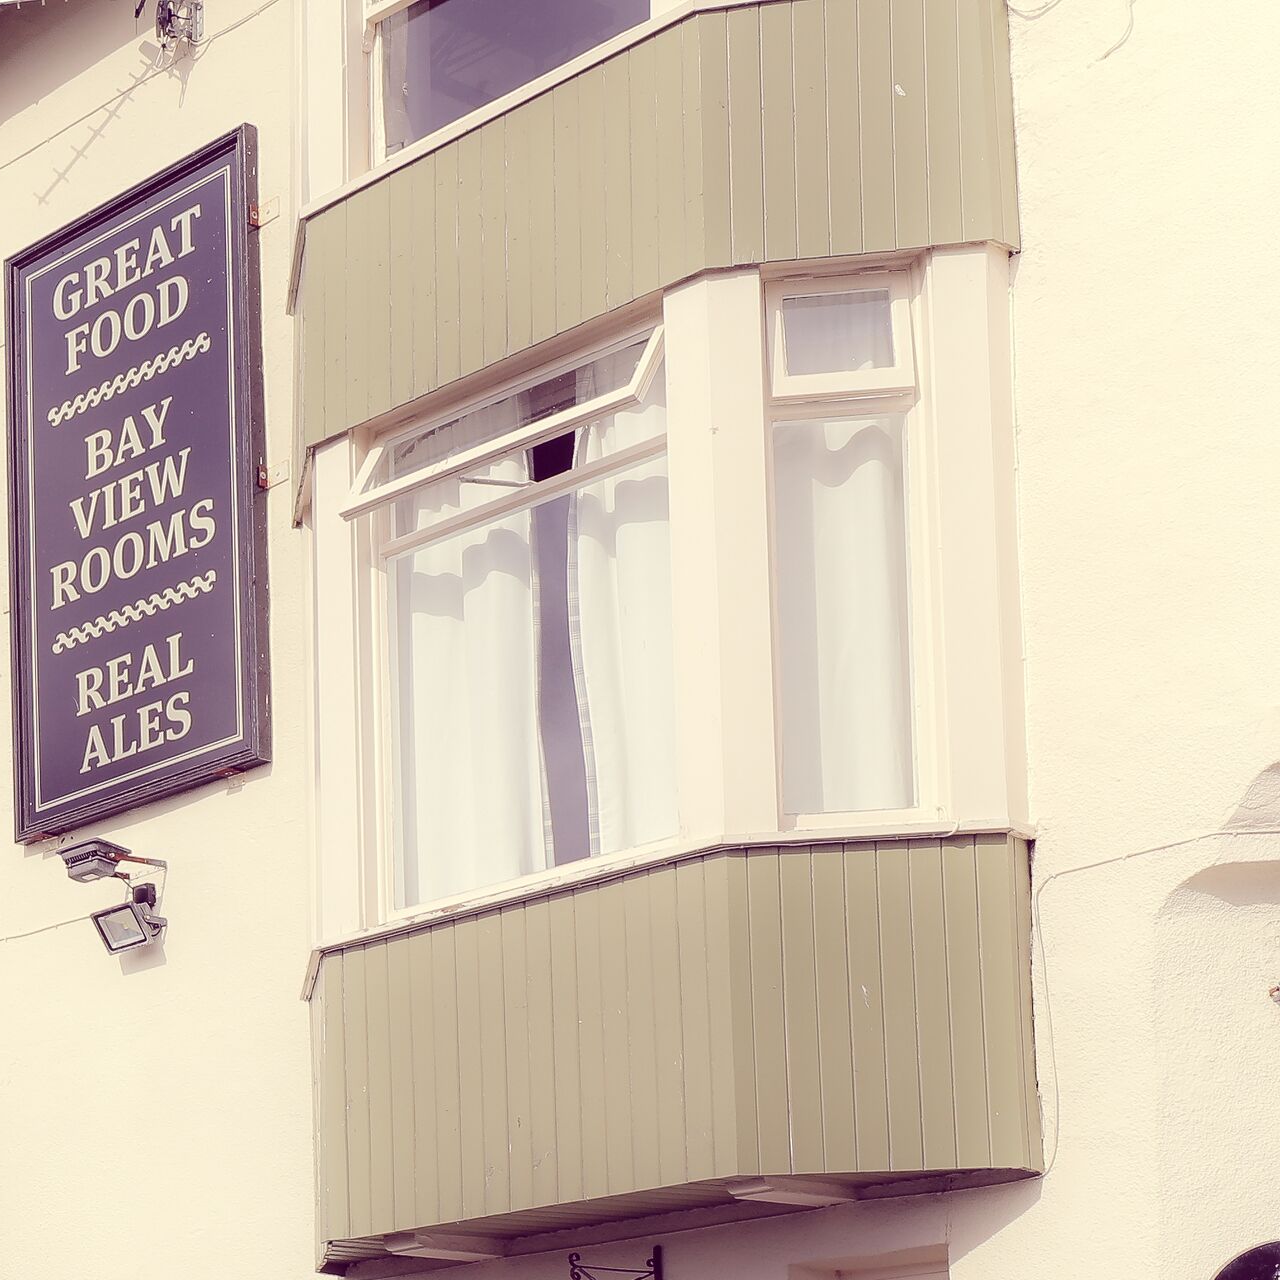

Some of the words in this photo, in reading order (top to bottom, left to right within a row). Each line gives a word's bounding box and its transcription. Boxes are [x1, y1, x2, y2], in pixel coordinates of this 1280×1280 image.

[52, 204, 203, 321] GREAT
[64, 275, 189, 375] FOOD
[85, 396, 173, 480] BAY
[69, 447, 193, 540] VIEW
[50, 499, 216, 611] ROOMS
[75, 632, 195, 717] REAL
[79, 691, 193, 775] ALES
